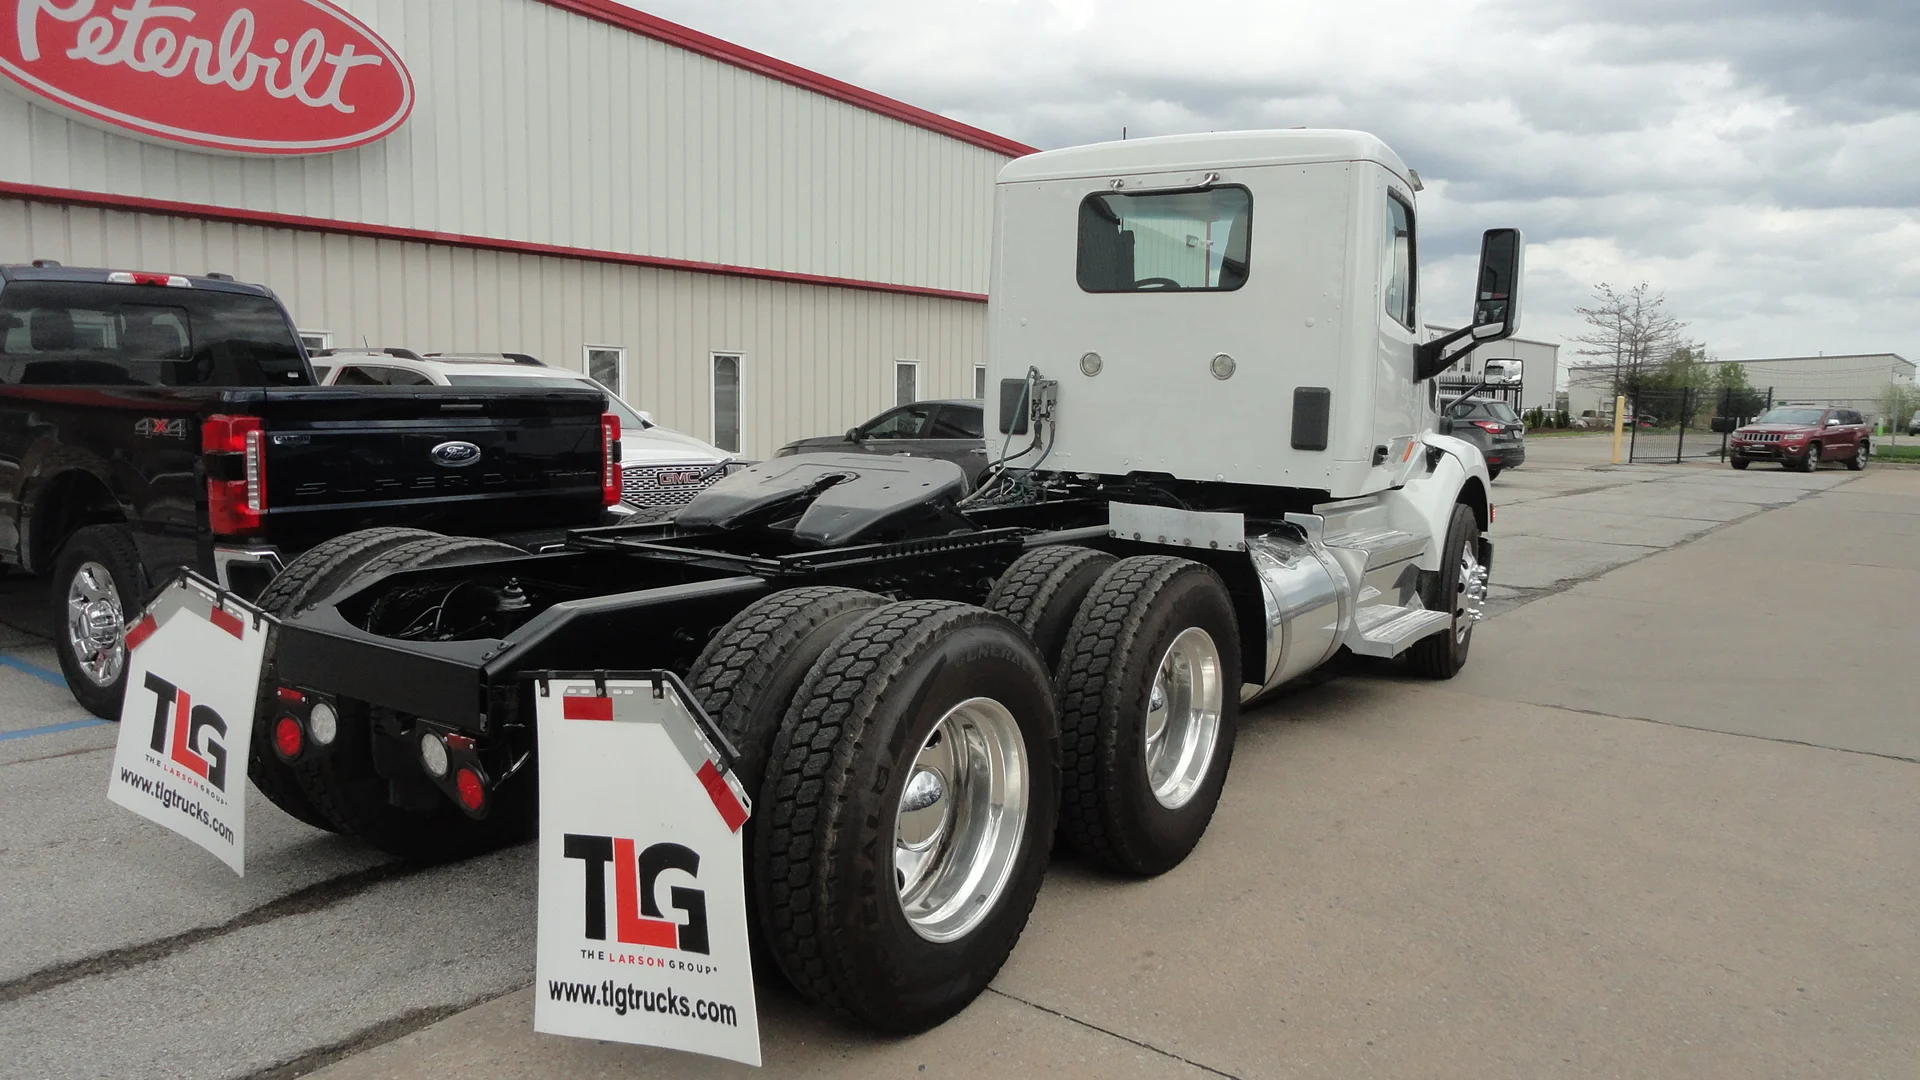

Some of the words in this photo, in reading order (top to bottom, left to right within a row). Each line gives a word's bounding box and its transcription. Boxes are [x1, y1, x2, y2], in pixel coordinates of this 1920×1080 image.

[660, 472, 700, 485] GMC
[144, 670, 228, 794] TLG
[145, 754, 162, 768] THE
[163, 764, 199, 788] LARSON
[120, 766, 235, 846] www.tlgtrucks.com
[563, 833, 711, 956] TLG
[580, 949, 605, 961] THE
[609, 953, 665, 968] LARSON
[668, 959, 711, 975] GROUP
[549, 980, 738, 1028] www.tlgtrucks.com
